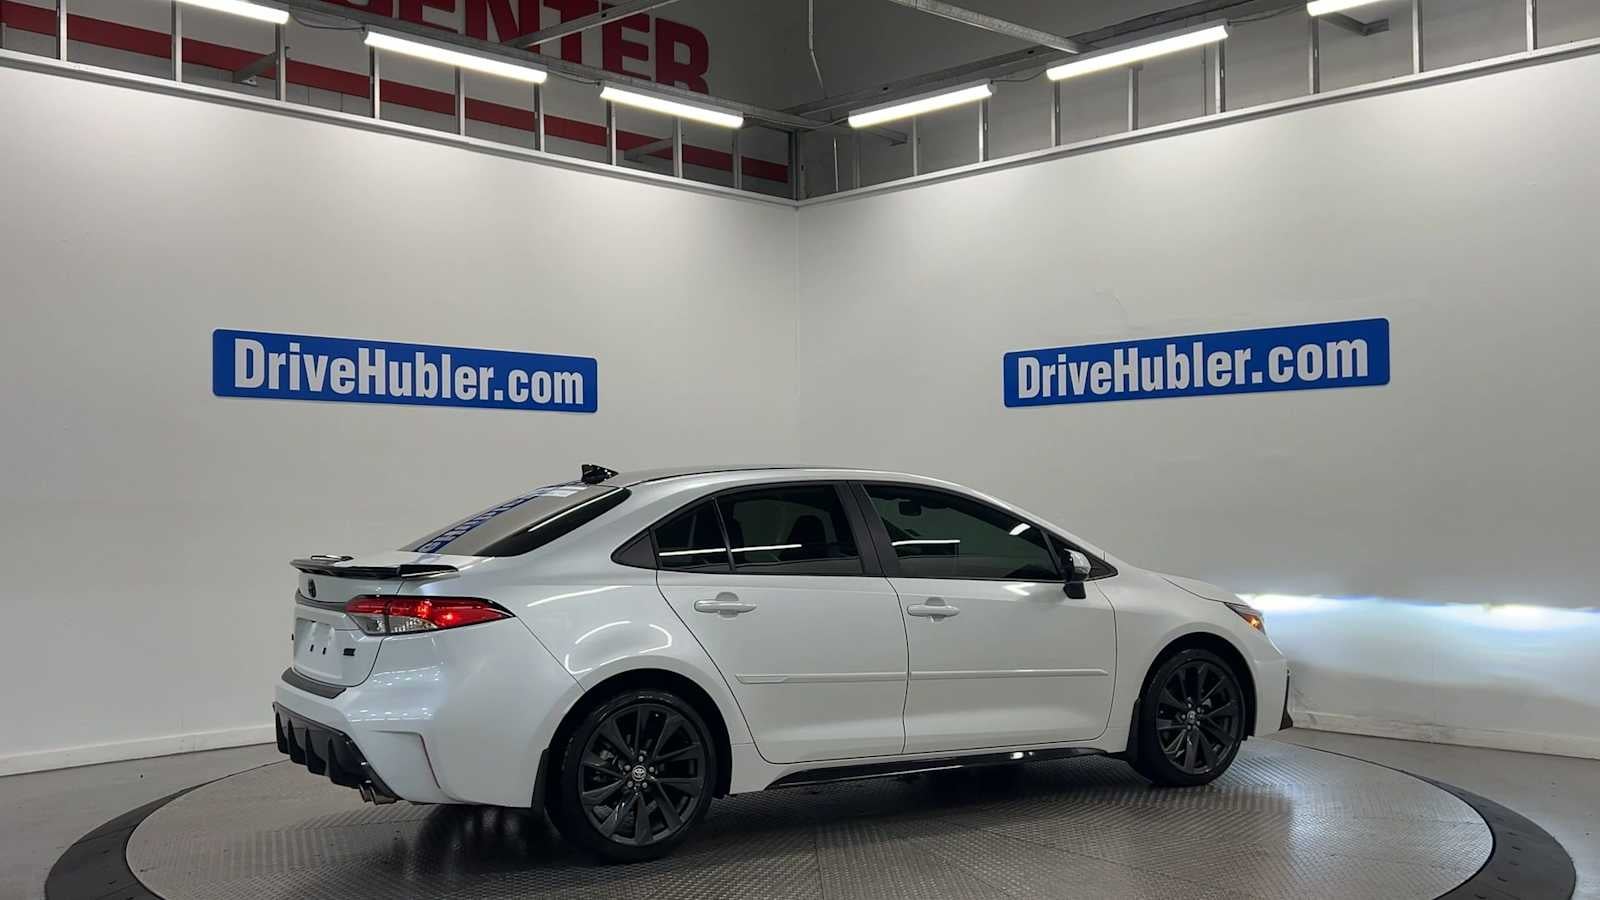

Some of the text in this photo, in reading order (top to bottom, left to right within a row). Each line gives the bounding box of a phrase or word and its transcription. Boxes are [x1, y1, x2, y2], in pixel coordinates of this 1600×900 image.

[321, 0, 709, 95] ENTER
[234, 338, 584, 405] DriveHubler.com
[1017, 337, 1368, 399] DriveHubler.com
